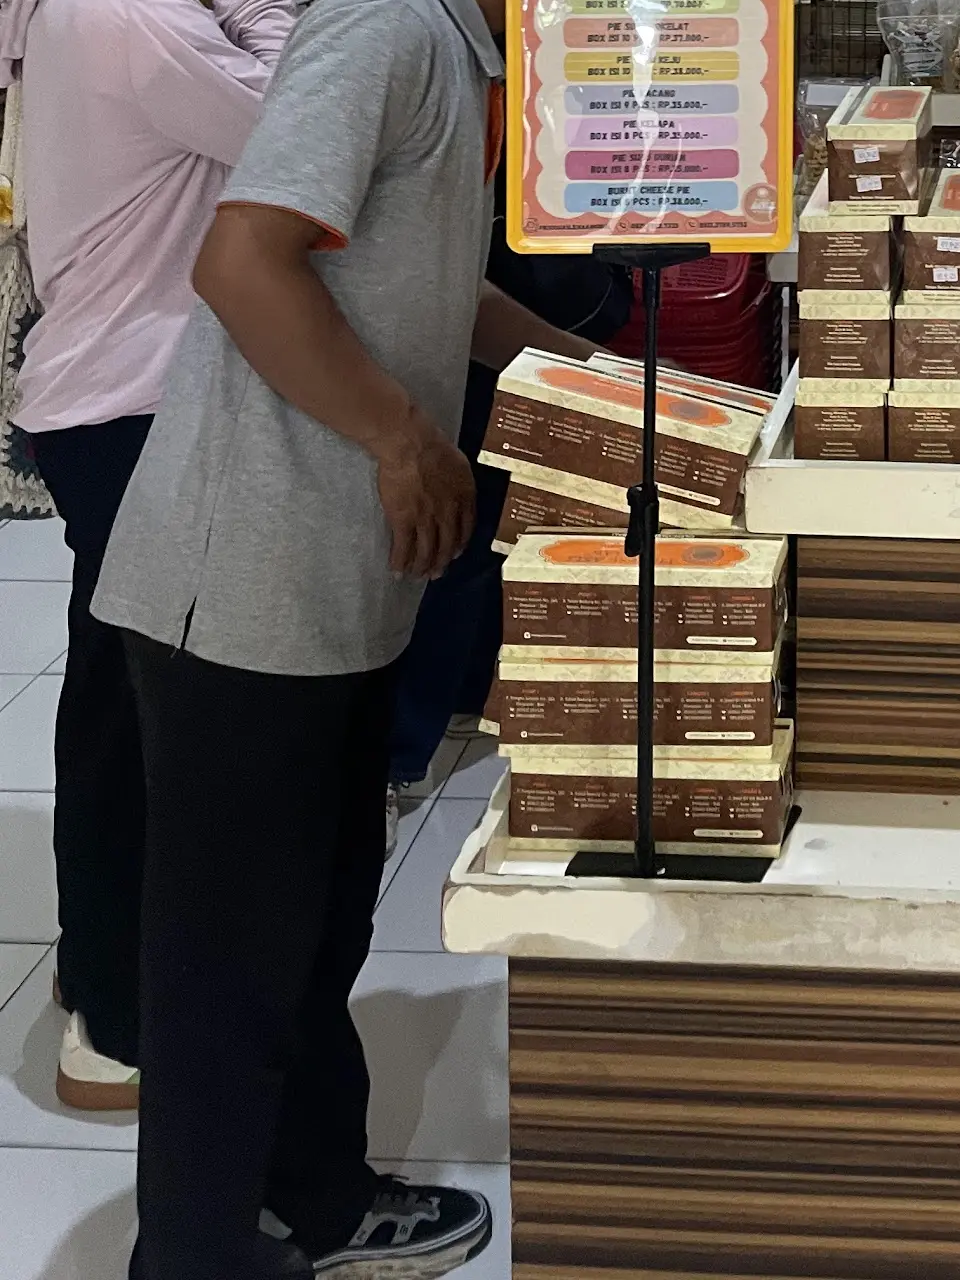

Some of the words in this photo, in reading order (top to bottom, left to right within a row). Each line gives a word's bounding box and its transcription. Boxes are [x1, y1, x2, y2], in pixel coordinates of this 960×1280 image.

[607, 22, 621, 31] PIE
[587, 34, 606, 43] BOX
[587, 67, 606, 76] BOX
[589, 101, 607, 110] BOX
[622, 119, 636, 129] PIE
[590, 131, 608, 140] BOX
[590, 165, 608, 174] BOX
[676, 185, 691, 195] PIE
[590, 197, 608, 207] BOX
[632, 197, 650, 207] PCS
